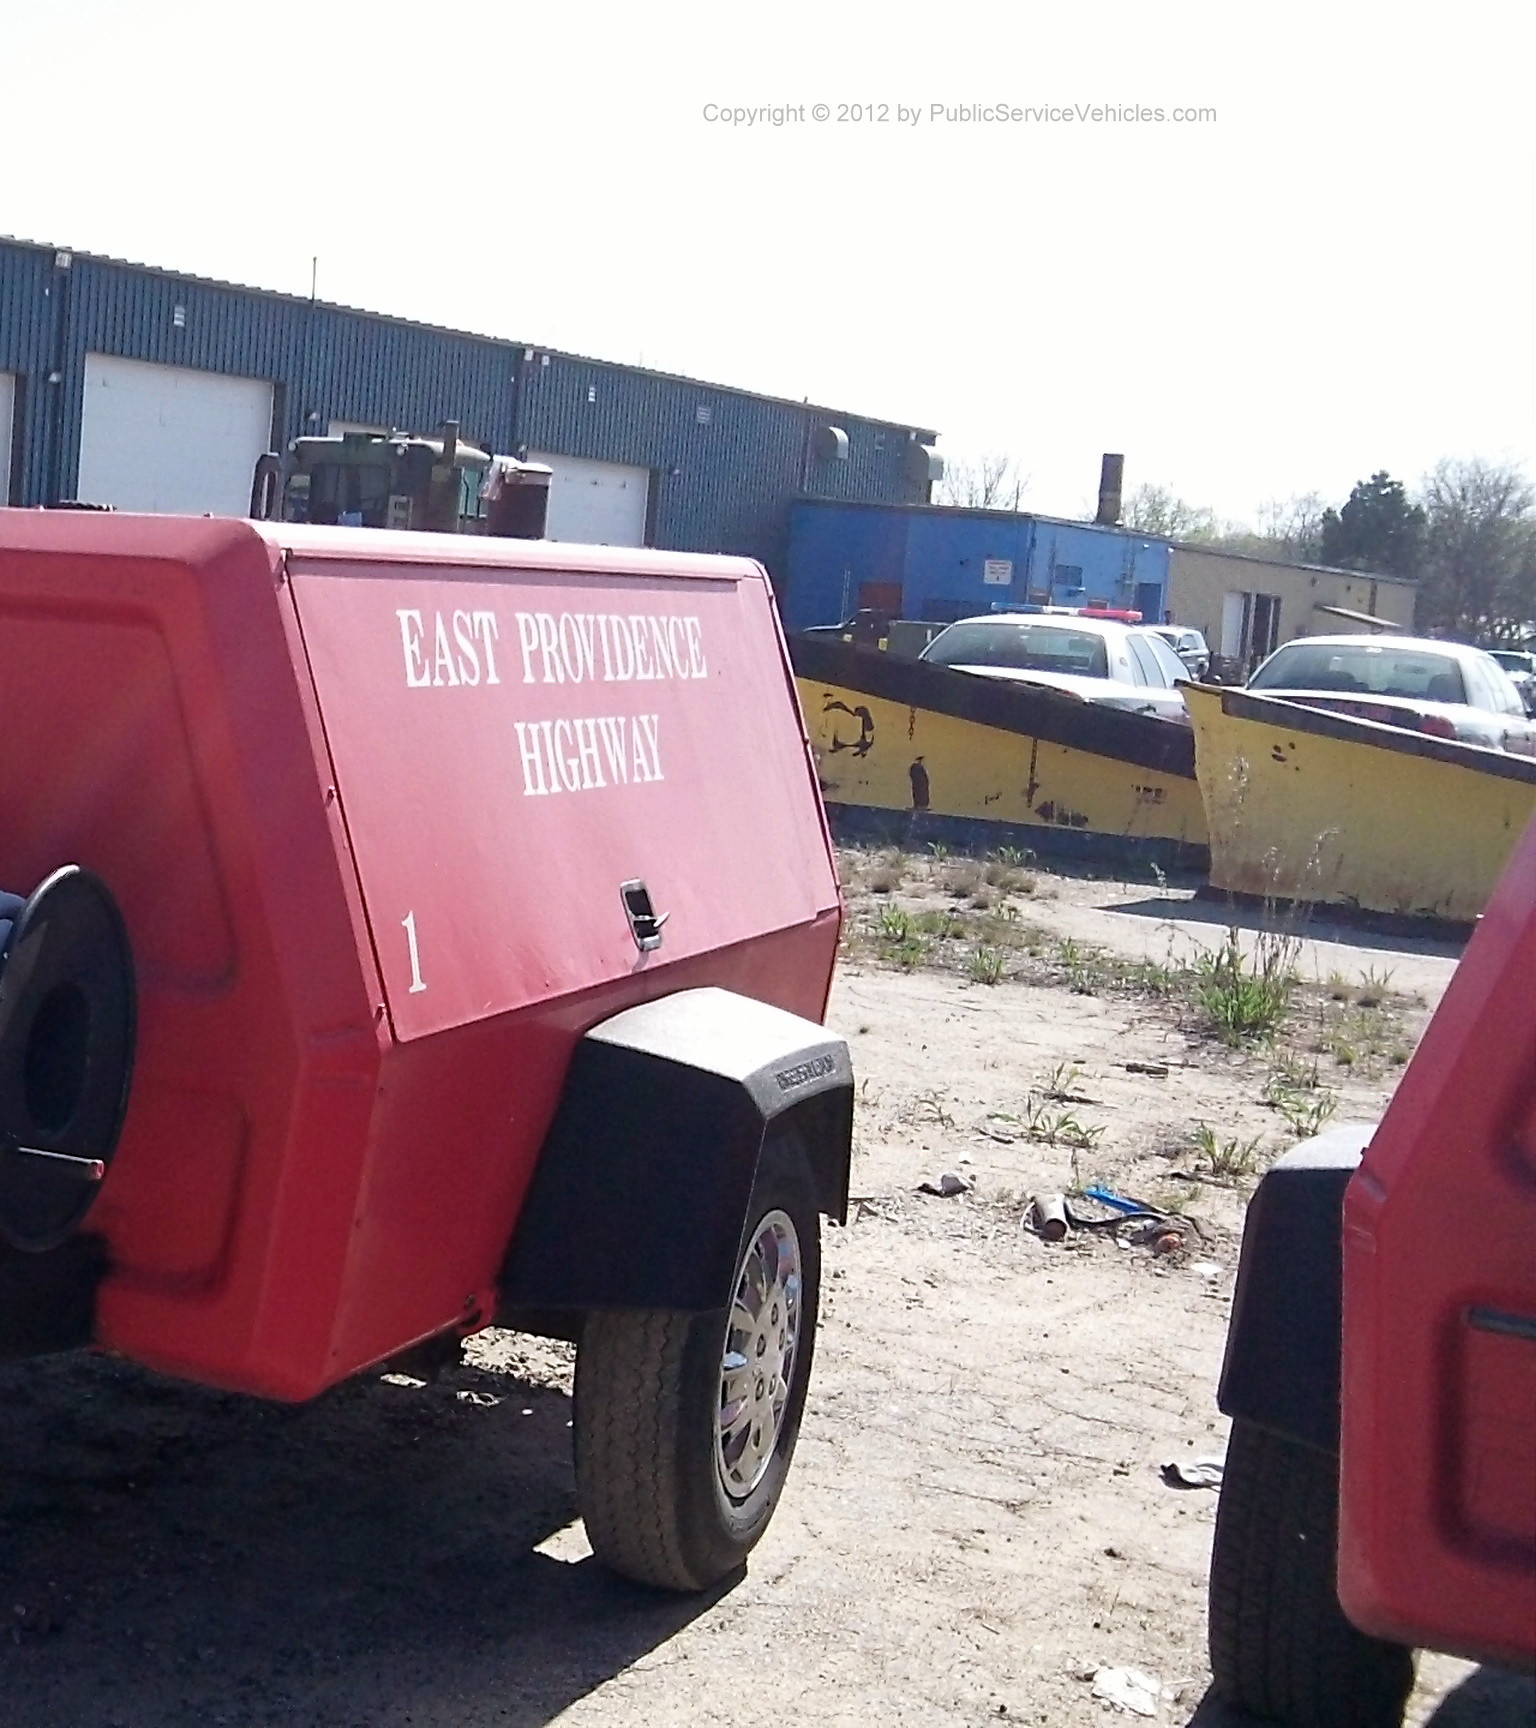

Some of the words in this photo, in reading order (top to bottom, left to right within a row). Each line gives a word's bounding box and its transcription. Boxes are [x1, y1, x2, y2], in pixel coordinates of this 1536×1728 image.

[396, 607, 501, 688] EAST
[514, 611, 708, 685] PROVIDENCE
[513, 715, 665, 796] HIGHWAY
[401, 909, 428, 994] 1
